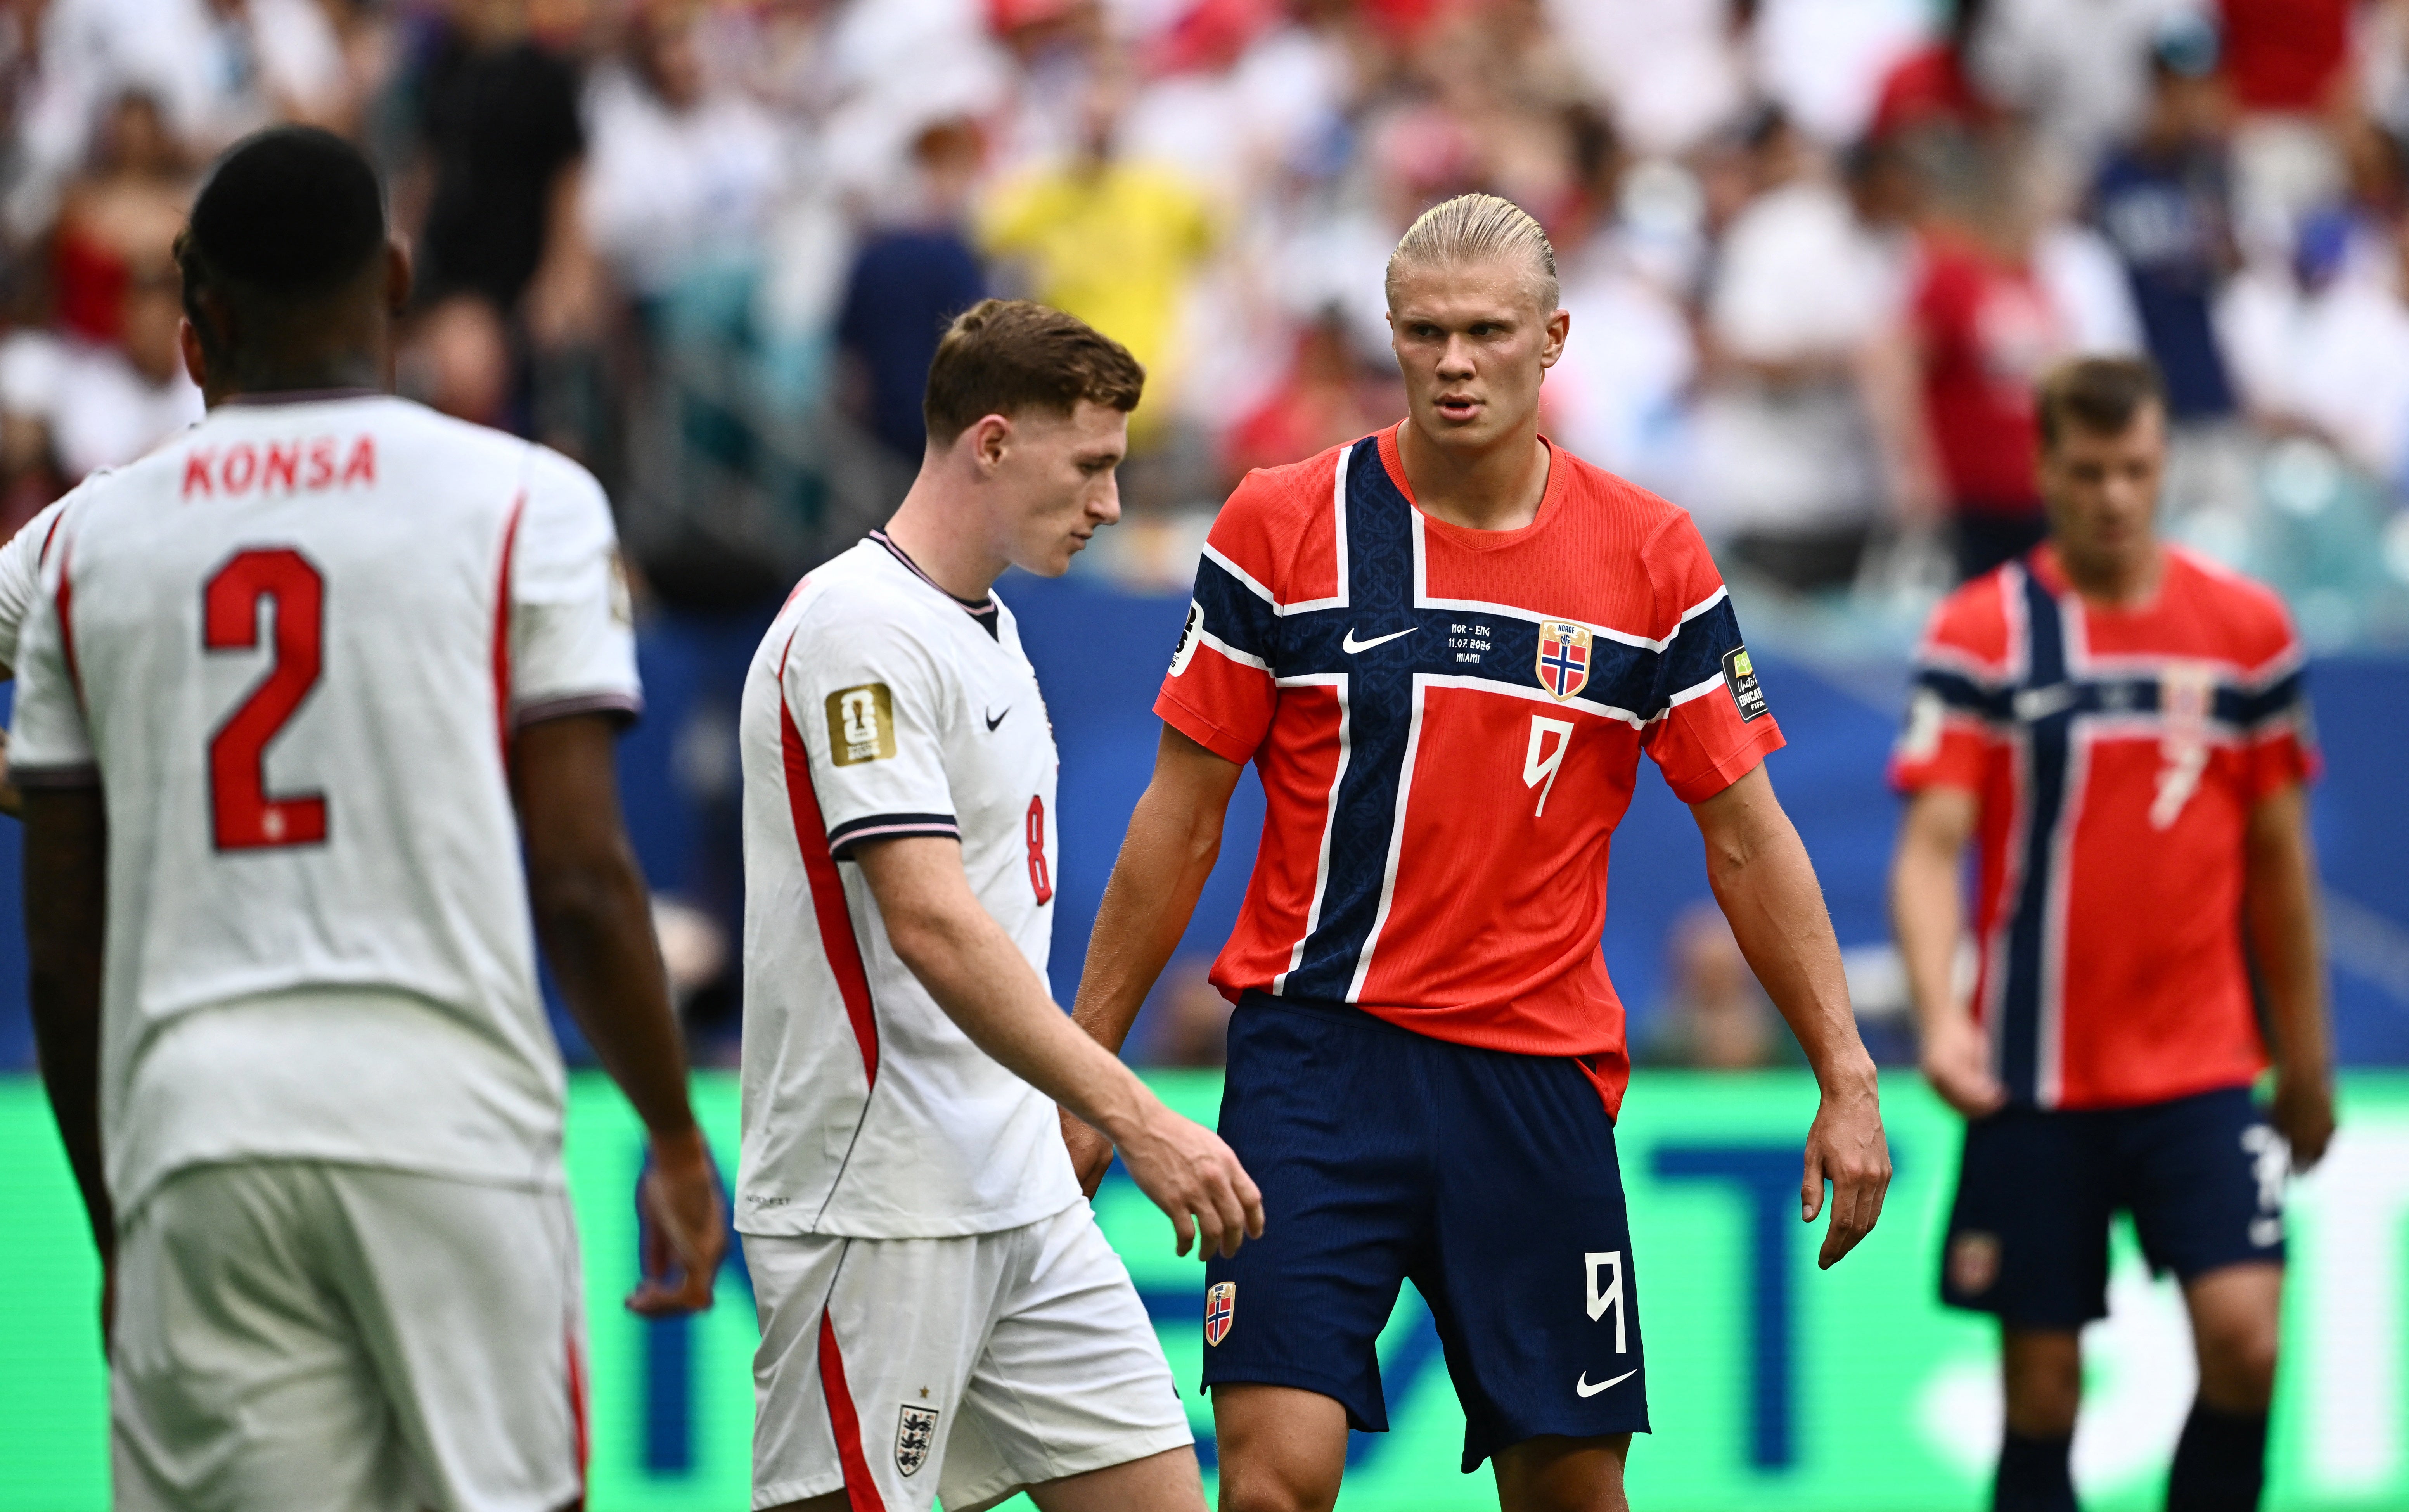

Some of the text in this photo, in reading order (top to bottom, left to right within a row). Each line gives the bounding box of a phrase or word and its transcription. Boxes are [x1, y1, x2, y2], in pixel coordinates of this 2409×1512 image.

[182, 432, 377, 501] KONSA
[1452, 624, 1466, 633] NOR
[1475, 625, 1490, 637] ENG
[1558, 625, 1575, 633] NORGE
[1456, 653, 1480, 663] MIAMI
[203, 546, 328, 853] 2
[1738, 677, 1755, 693] Unite
[1750, 700, 1765, 710] FIFA
[1523, 715, 1574, 817] 9
[1027, 794, 1052, 906] 8
[1585, 1251, 1626, 1353] 9
